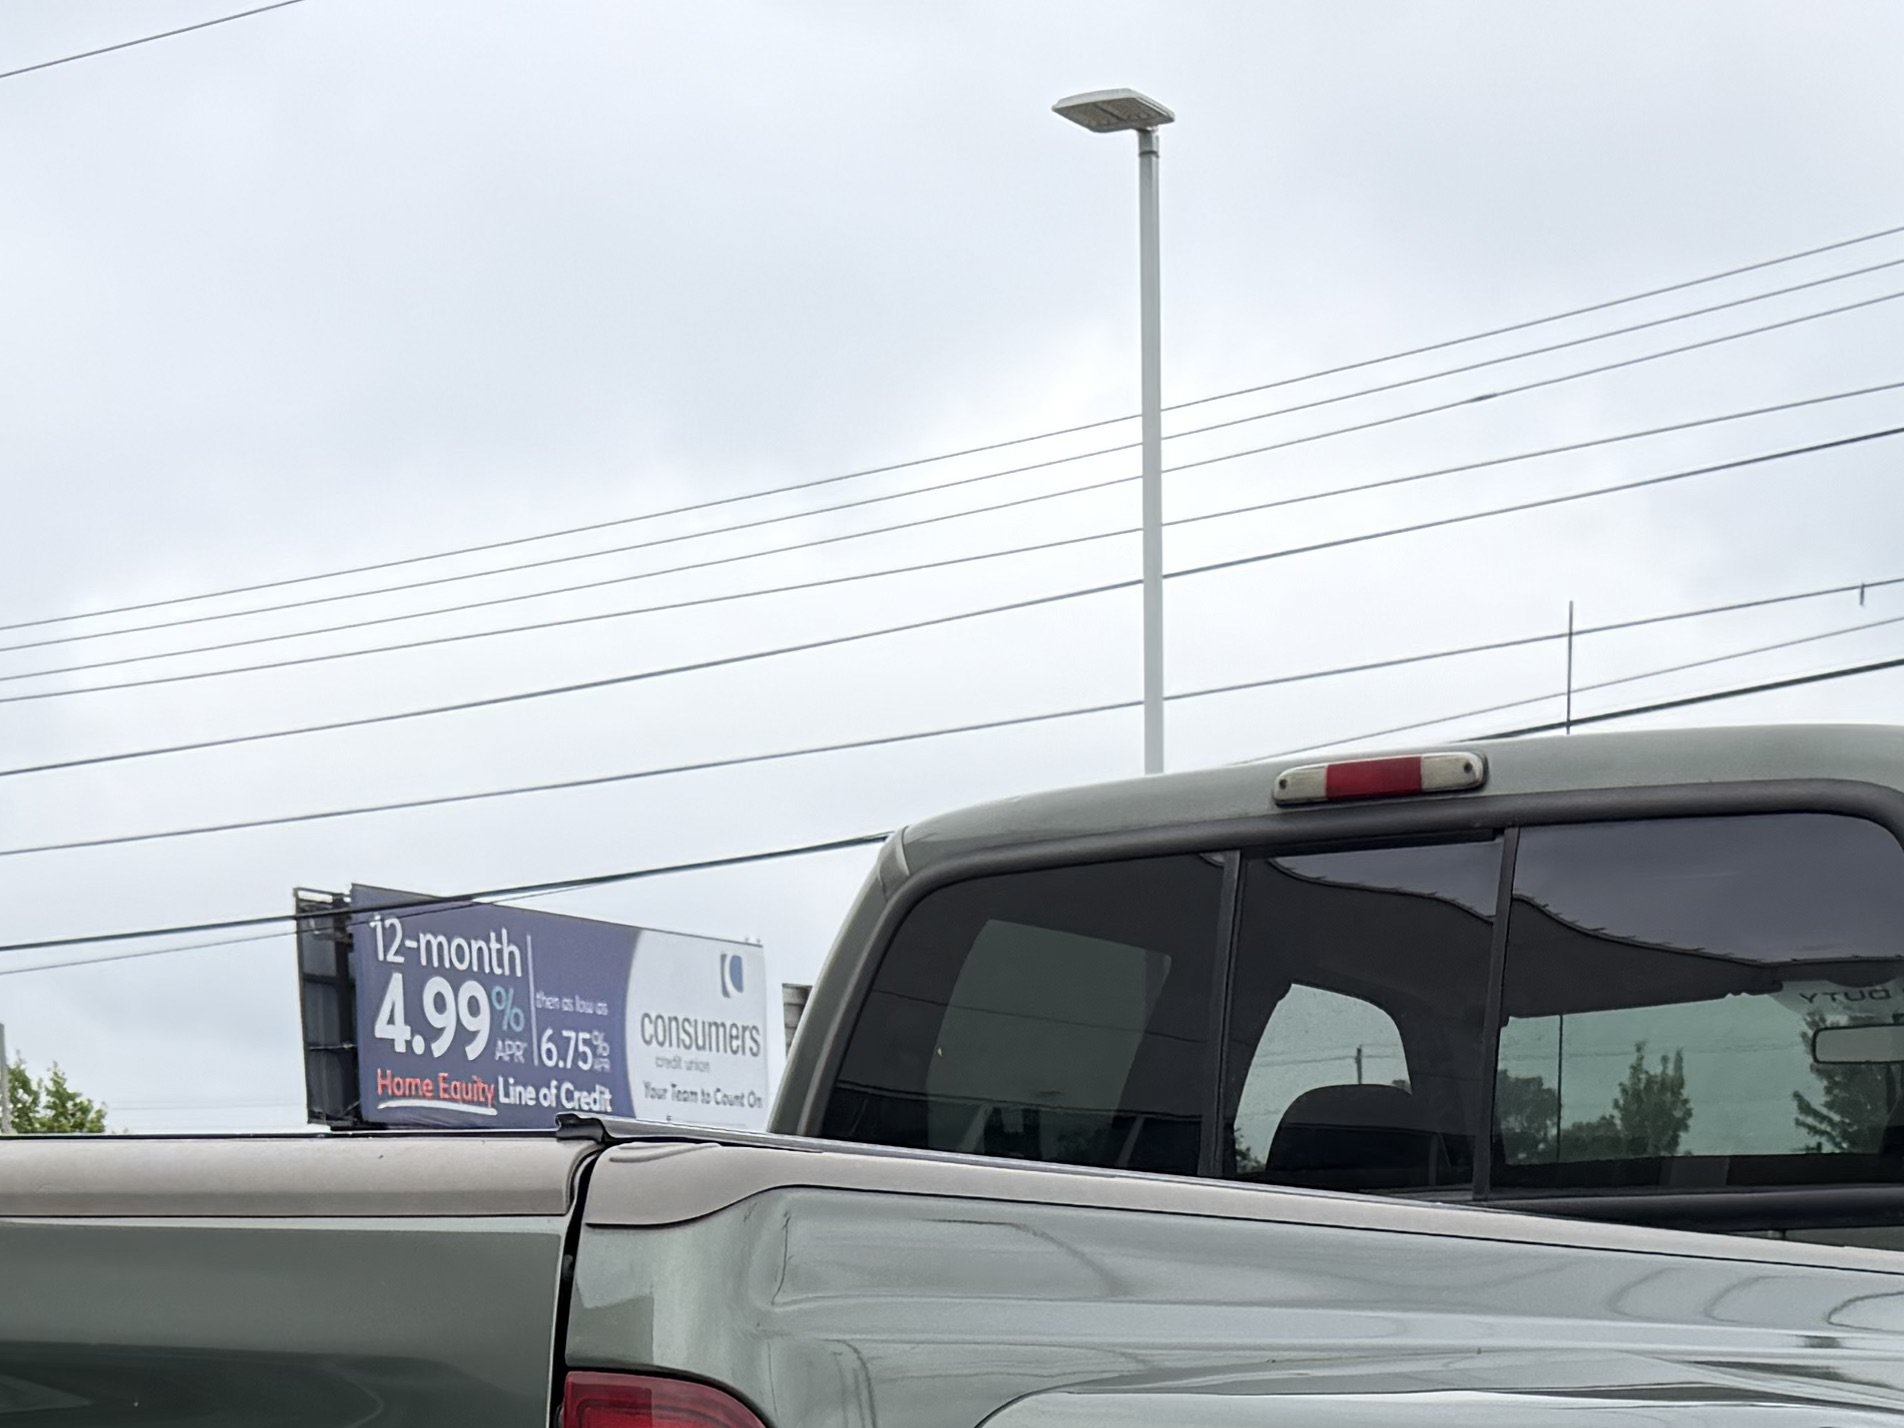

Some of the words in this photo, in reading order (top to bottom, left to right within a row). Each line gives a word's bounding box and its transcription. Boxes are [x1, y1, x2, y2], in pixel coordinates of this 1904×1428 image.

[370, 915, 521, 977] 12-month
[640, 1012, 760, 1058] consumers
[377, 1068, 434, 1097] Home
[438, 1073, 496, 1106] Equity
[498, 1075, 536, 1106] Line
[539, 1078, 558, 1107] of
[560, 1081, 613, 1113] Credit
[643, 1080, 668, 1100] Your
[671, 1083, 698, 1103] Team
[701, 1088, 712, 1105] to
[714, 1088, 745, 1108] Count
[747, 1089, 764, 1109] On
